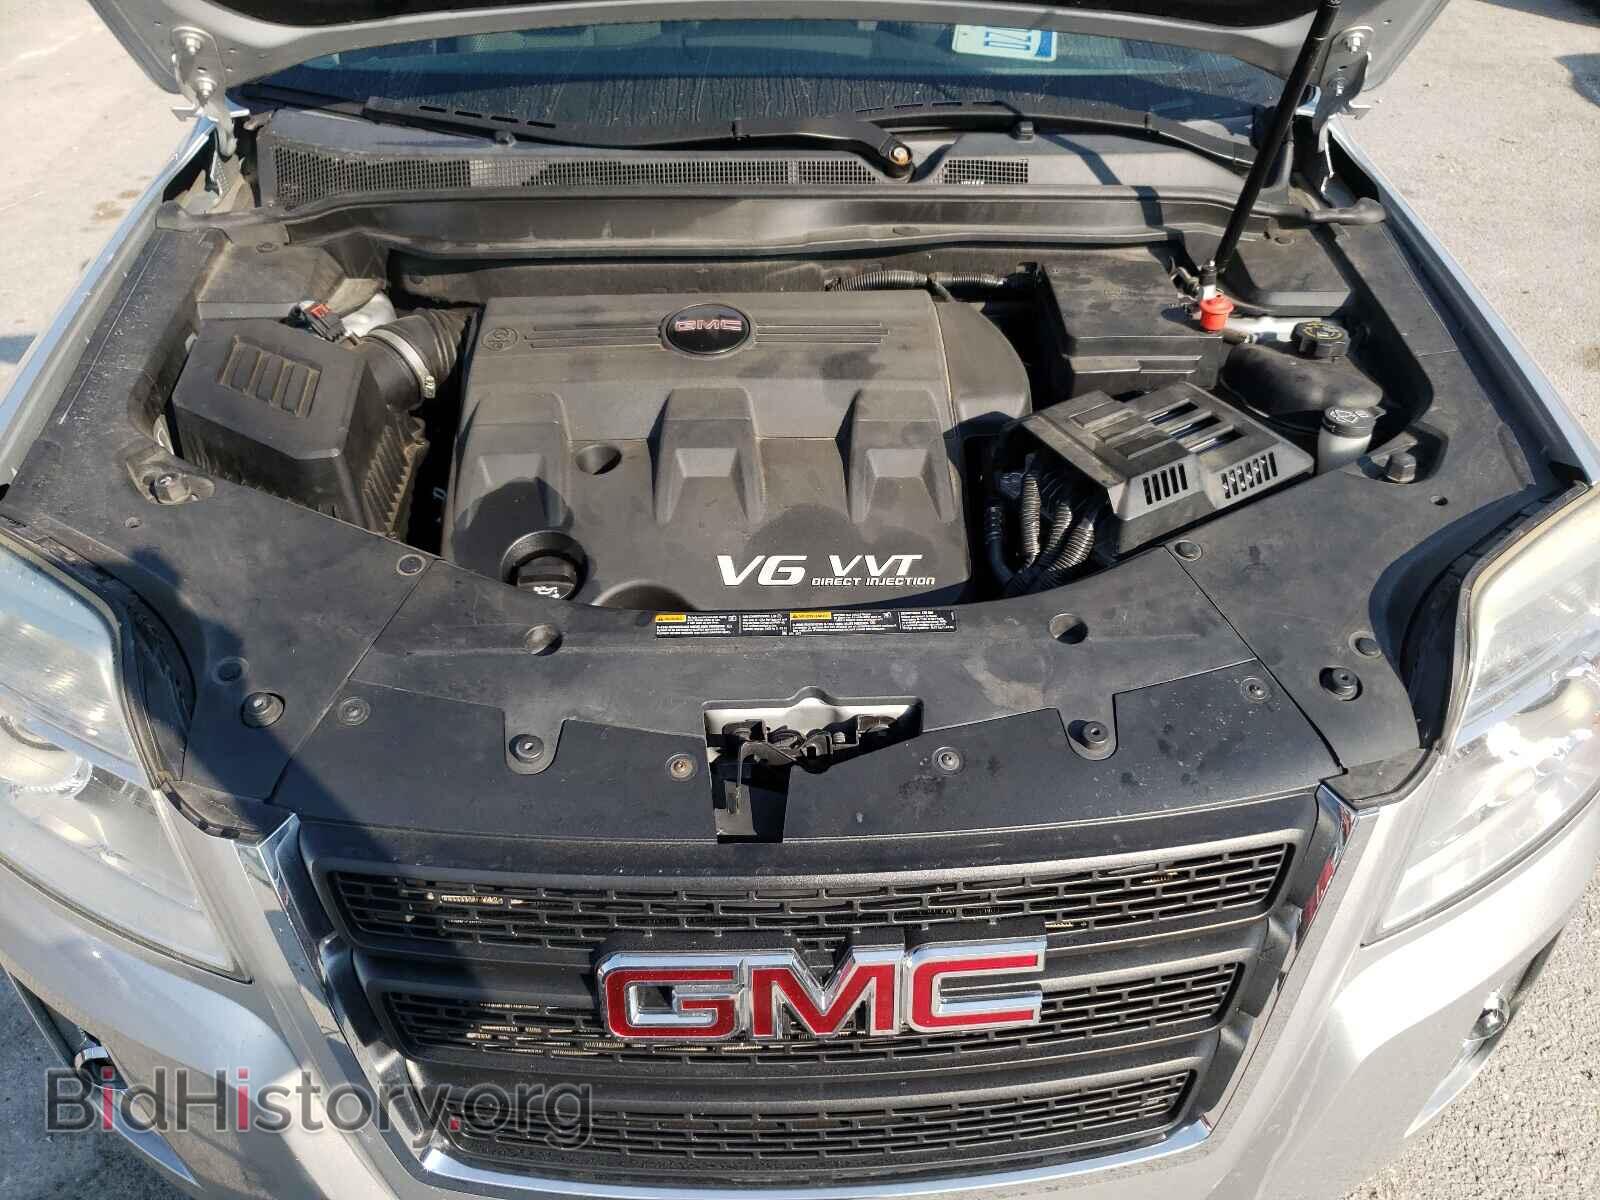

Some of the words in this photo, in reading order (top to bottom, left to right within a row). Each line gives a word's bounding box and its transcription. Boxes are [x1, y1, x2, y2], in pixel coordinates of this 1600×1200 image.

[674, 318, 743, 332] GMC
[716, 554, 808, 587] V6
[828, 554, 924, 577] VVT
[811, 577, 862, 587] DIRECT
[865, 576, 936, 587] INJECTION
[596, 935, 1047, 1039] GMC
